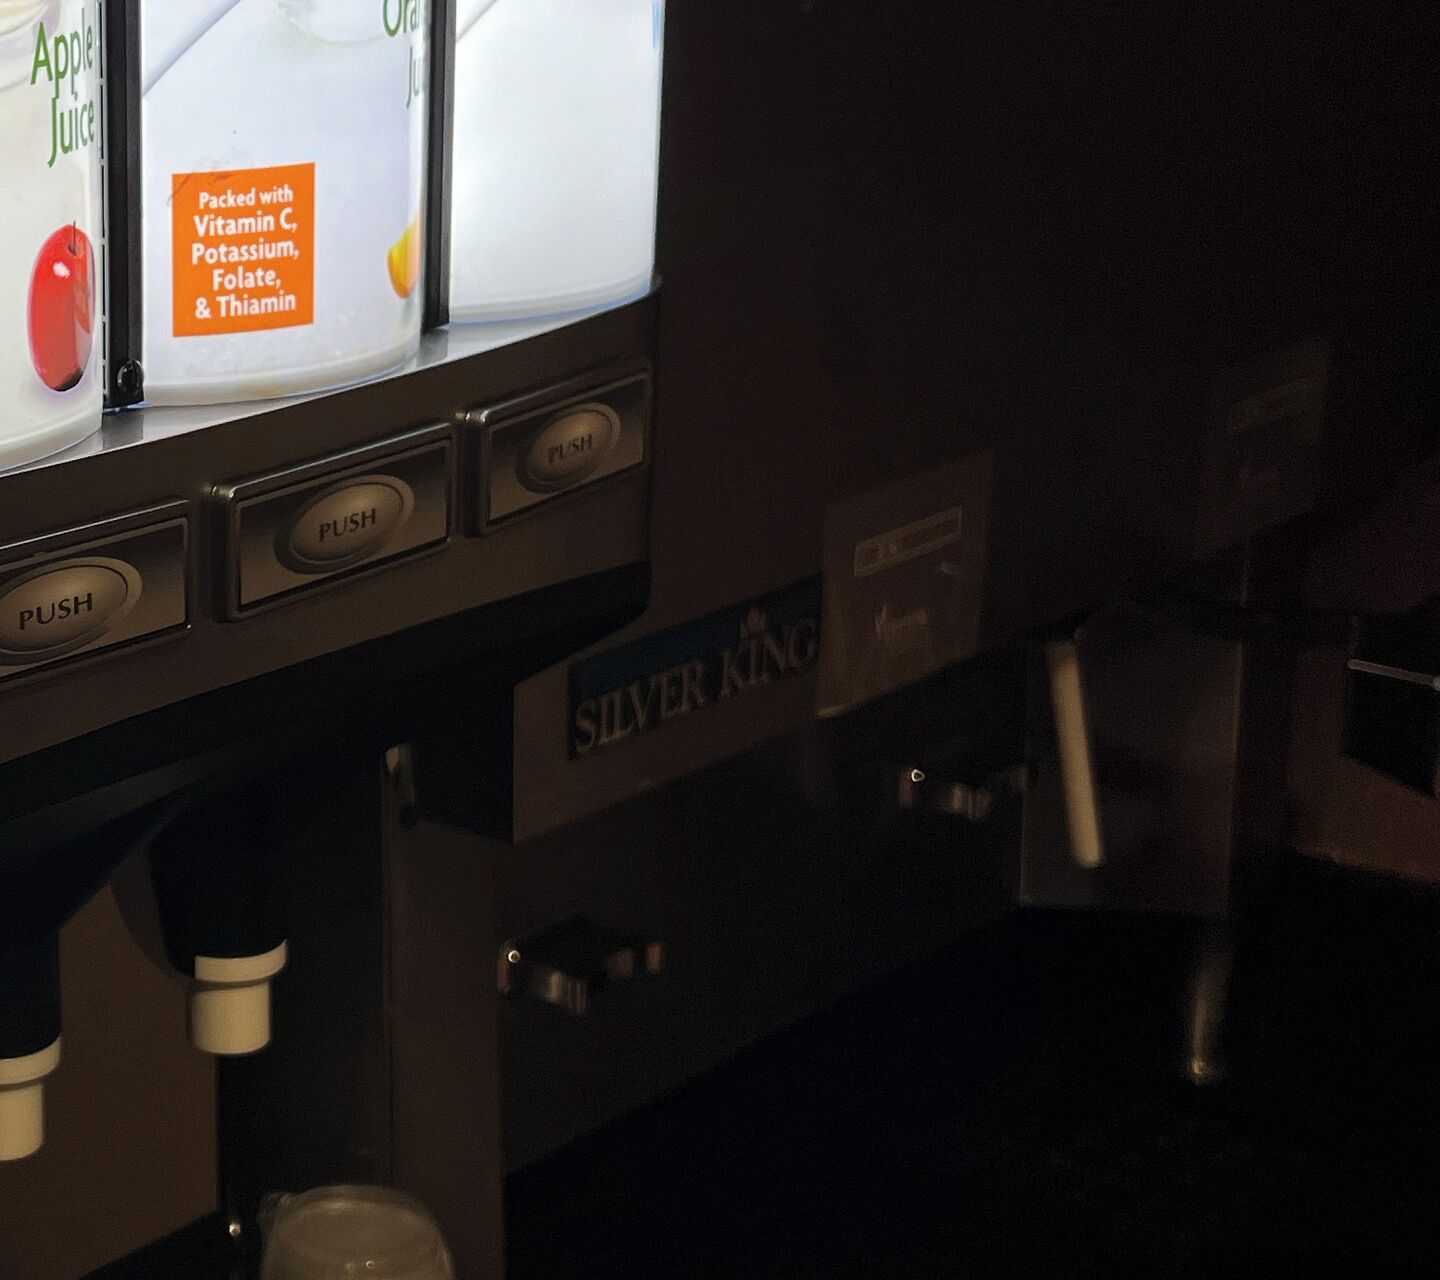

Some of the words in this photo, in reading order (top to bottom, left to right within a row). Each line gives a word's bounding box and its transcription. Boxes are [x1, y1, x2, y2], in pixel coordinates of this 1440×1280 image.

[30, 8, 93, 97] Apple
[47, 91, 95, 168] Juice
[199, 187, 256, 210] Packed
[259, 184, 293, 203] with
[194, 210, 275, 237] Vitamin
[279, 208, 297, 232] C,
[192, 238, 299, 265] Potassium,
[213, 266, 281, 291] Folate,
[195, 297, 212, 320] &
[216, 290, 296, 318] Thiamin
[319, 508, 377, 543] PUSH
[19, 592, 93, 631] PUSH
[576, 659, 706, 755] SILVER
[720, 620, 819, 700] KING
